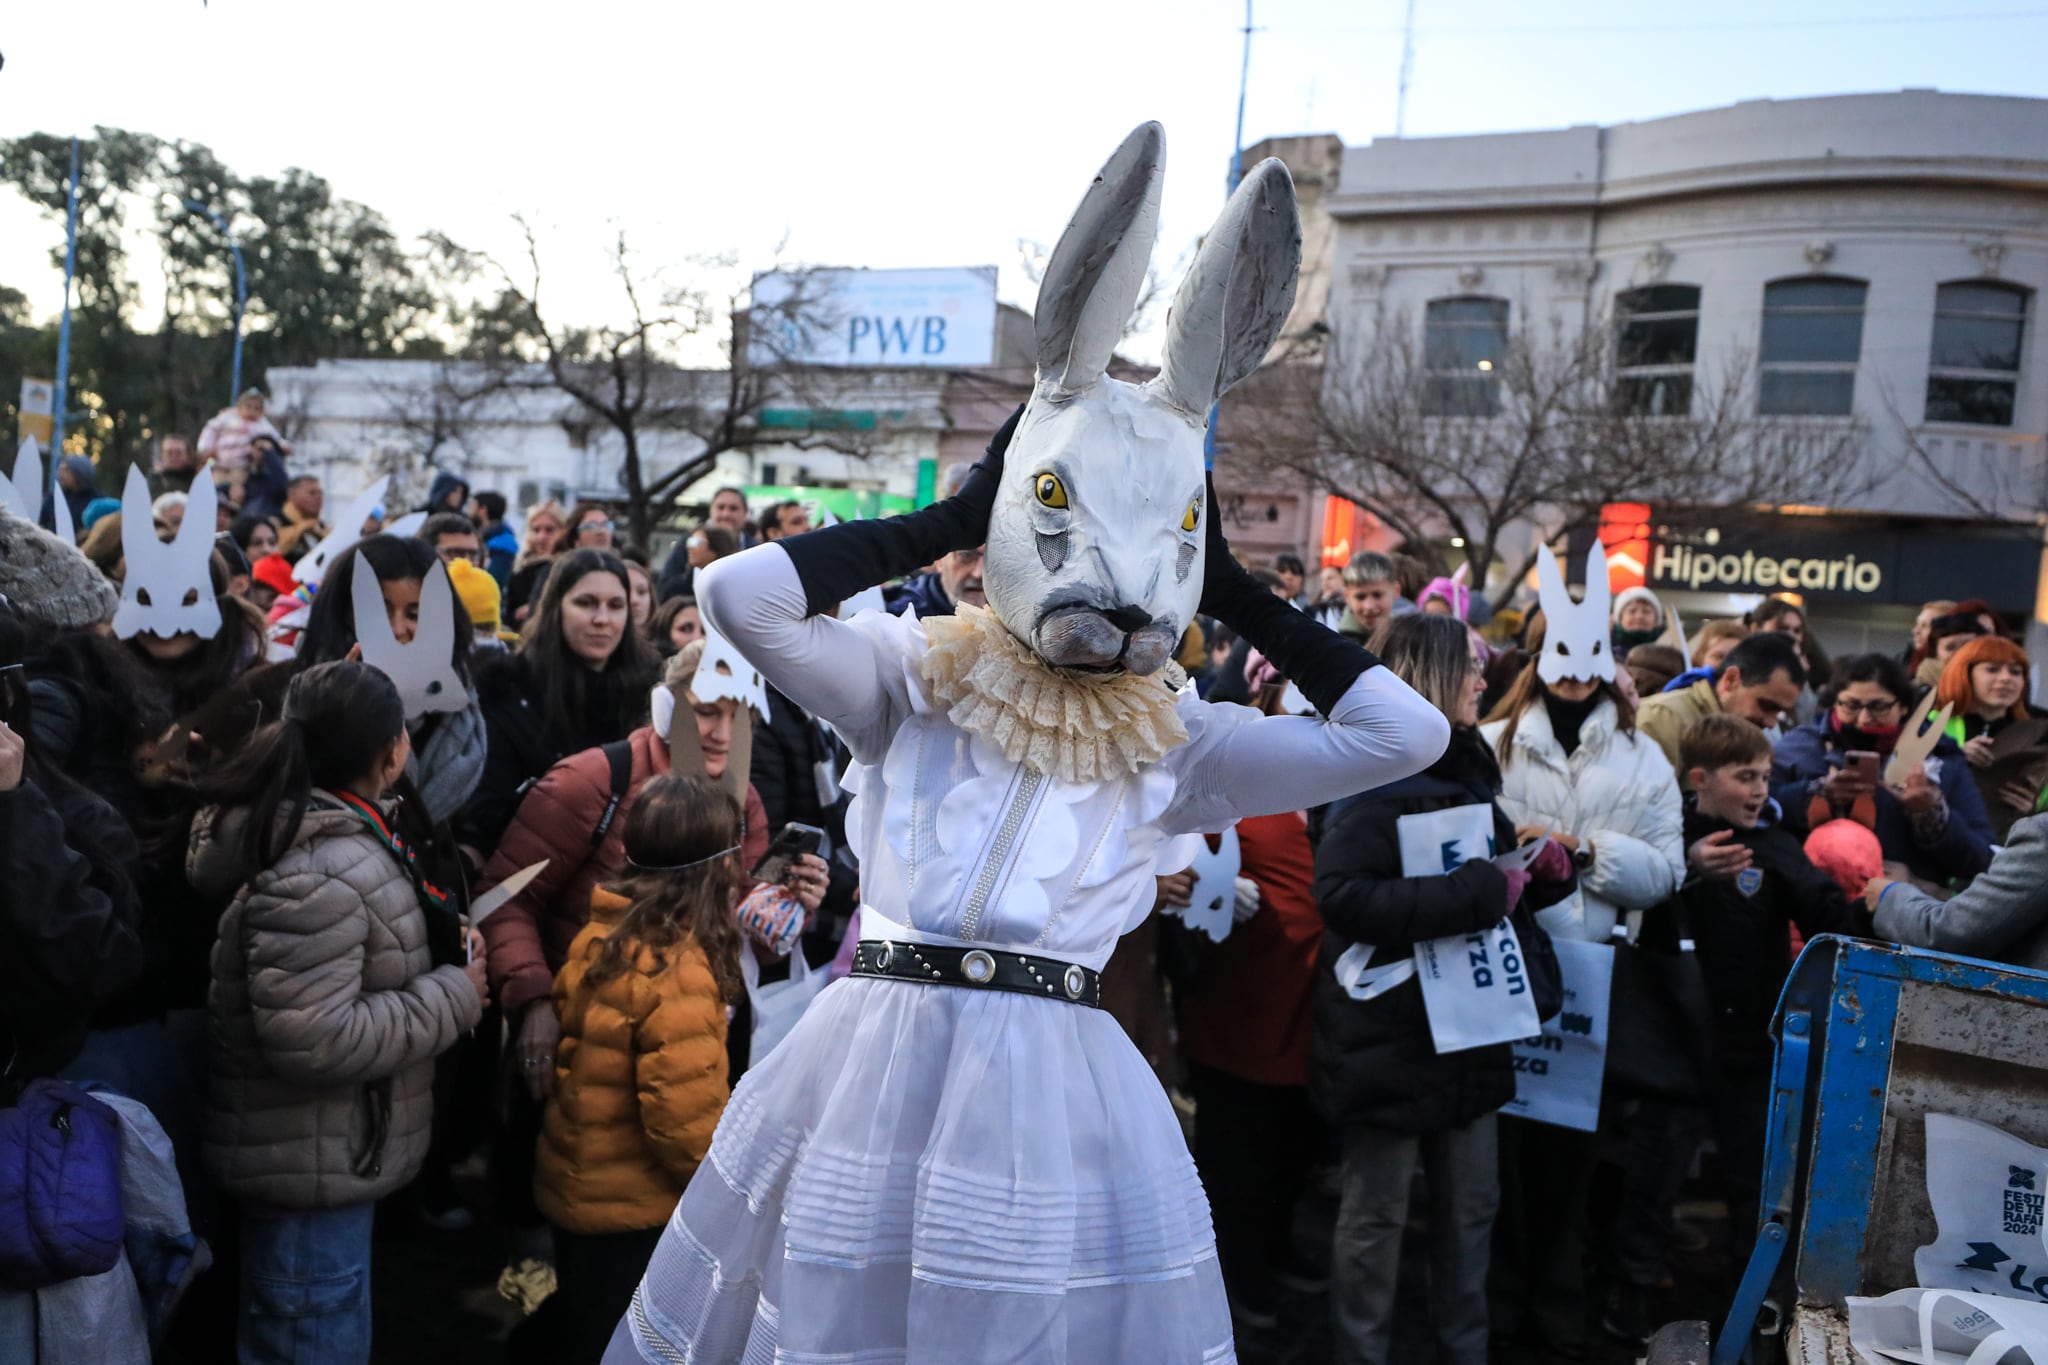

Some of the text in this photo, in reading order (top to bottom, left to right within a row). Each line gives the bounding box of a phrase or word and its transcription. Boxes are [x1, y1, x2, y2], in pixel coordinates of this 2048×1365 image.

[850, 315, 947, 355] PWB
[1653, 544, 1882, 593] Hipotecario
[1499, 938, 1526, 996] con
[2003, 1200, 2024, 1213] DE
[2003, 1222, 2036, 1236] 2024
